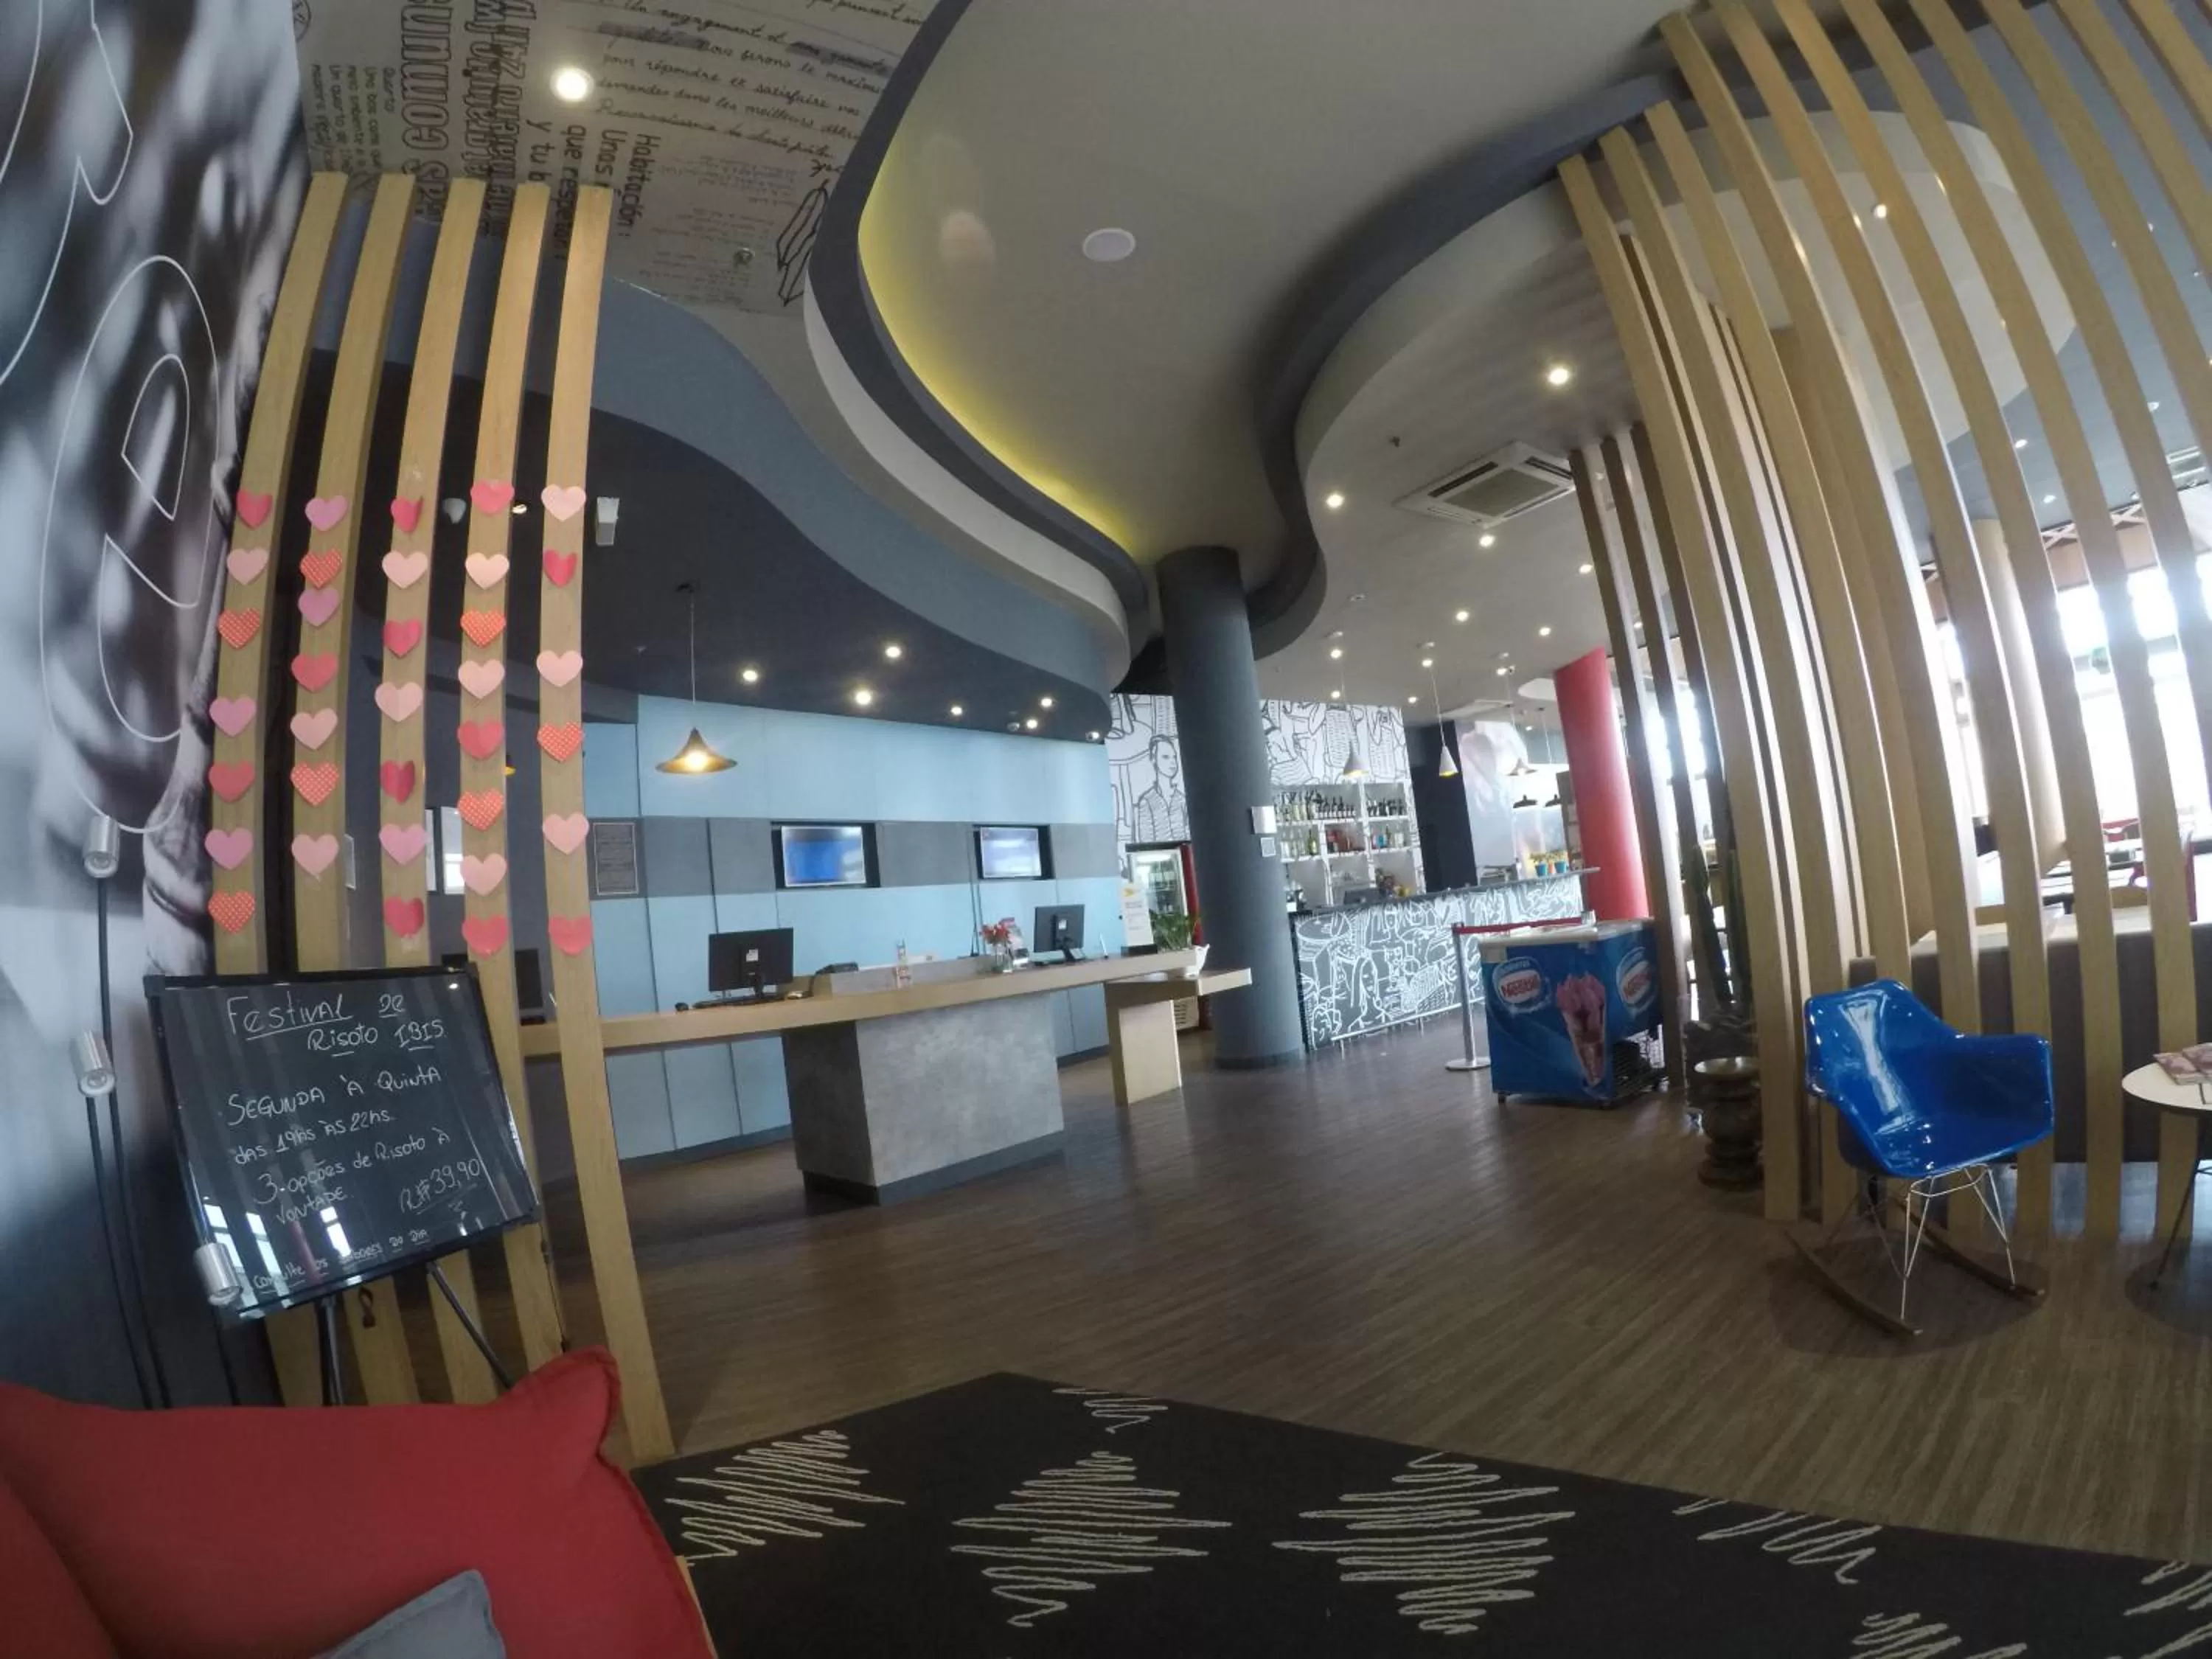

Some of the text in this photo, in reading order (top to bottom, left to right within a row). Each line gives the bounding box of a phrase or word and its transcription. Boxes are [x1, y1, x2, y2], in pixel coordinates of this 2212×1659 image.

[560, 125, 588, 160] que
[594, 129, 629, 176] Unas
[229, 1087, 326, 1126] SEGUNDA
